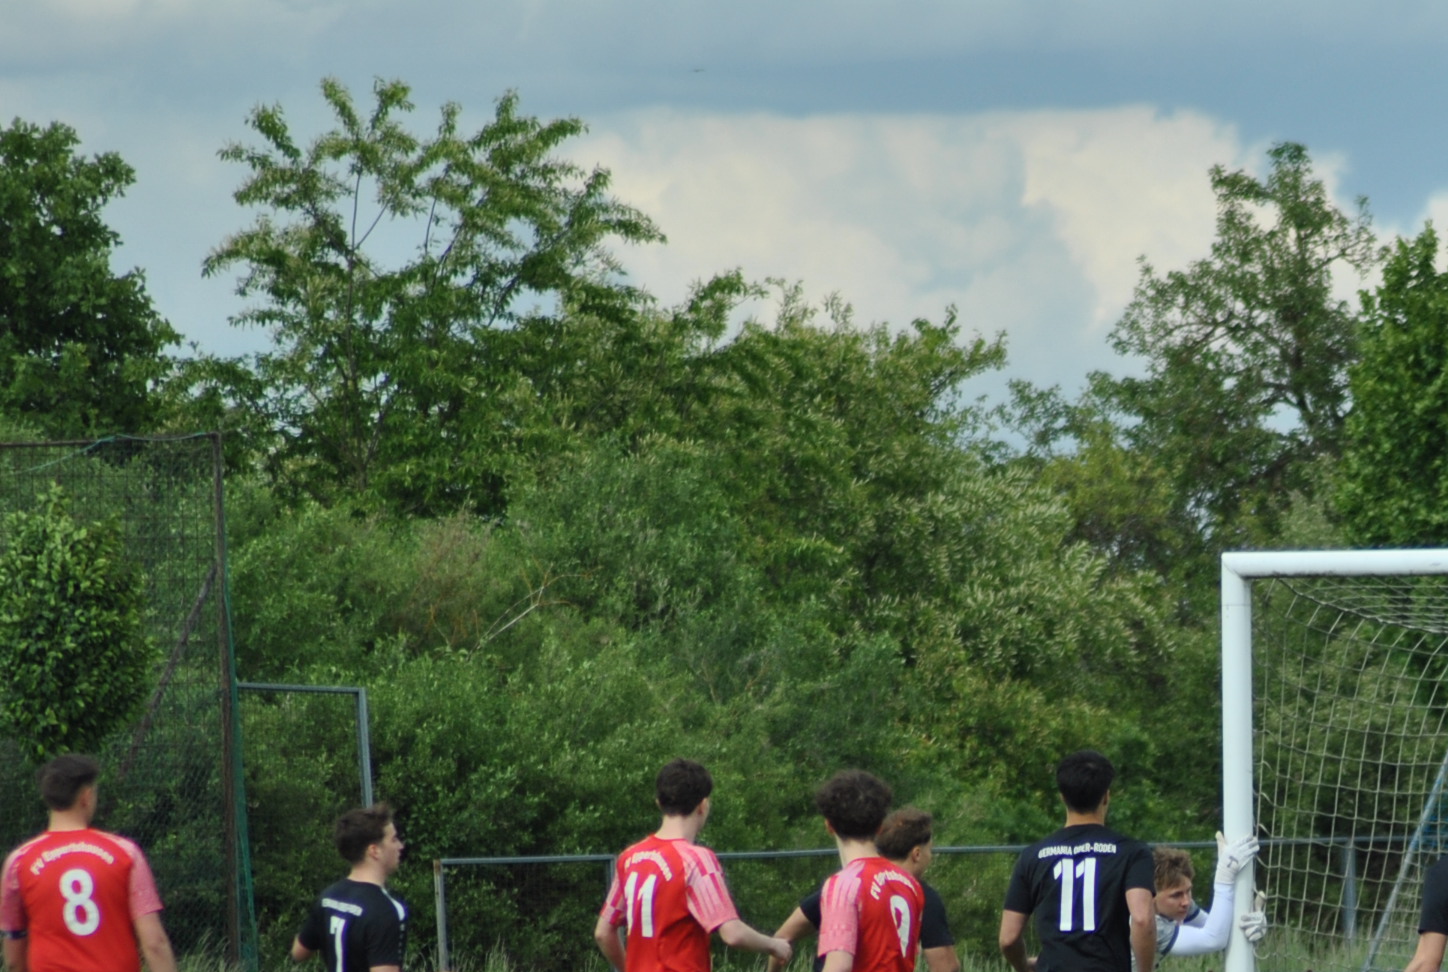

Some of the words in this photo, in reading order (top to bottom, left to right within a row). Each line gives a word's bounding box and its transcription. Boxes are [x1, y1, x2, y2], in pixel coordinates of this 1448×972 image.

[59, 868, 100, 936] 8
[624, 871, 657, 938] 11
[1053, 857, 1096, 931] 11
